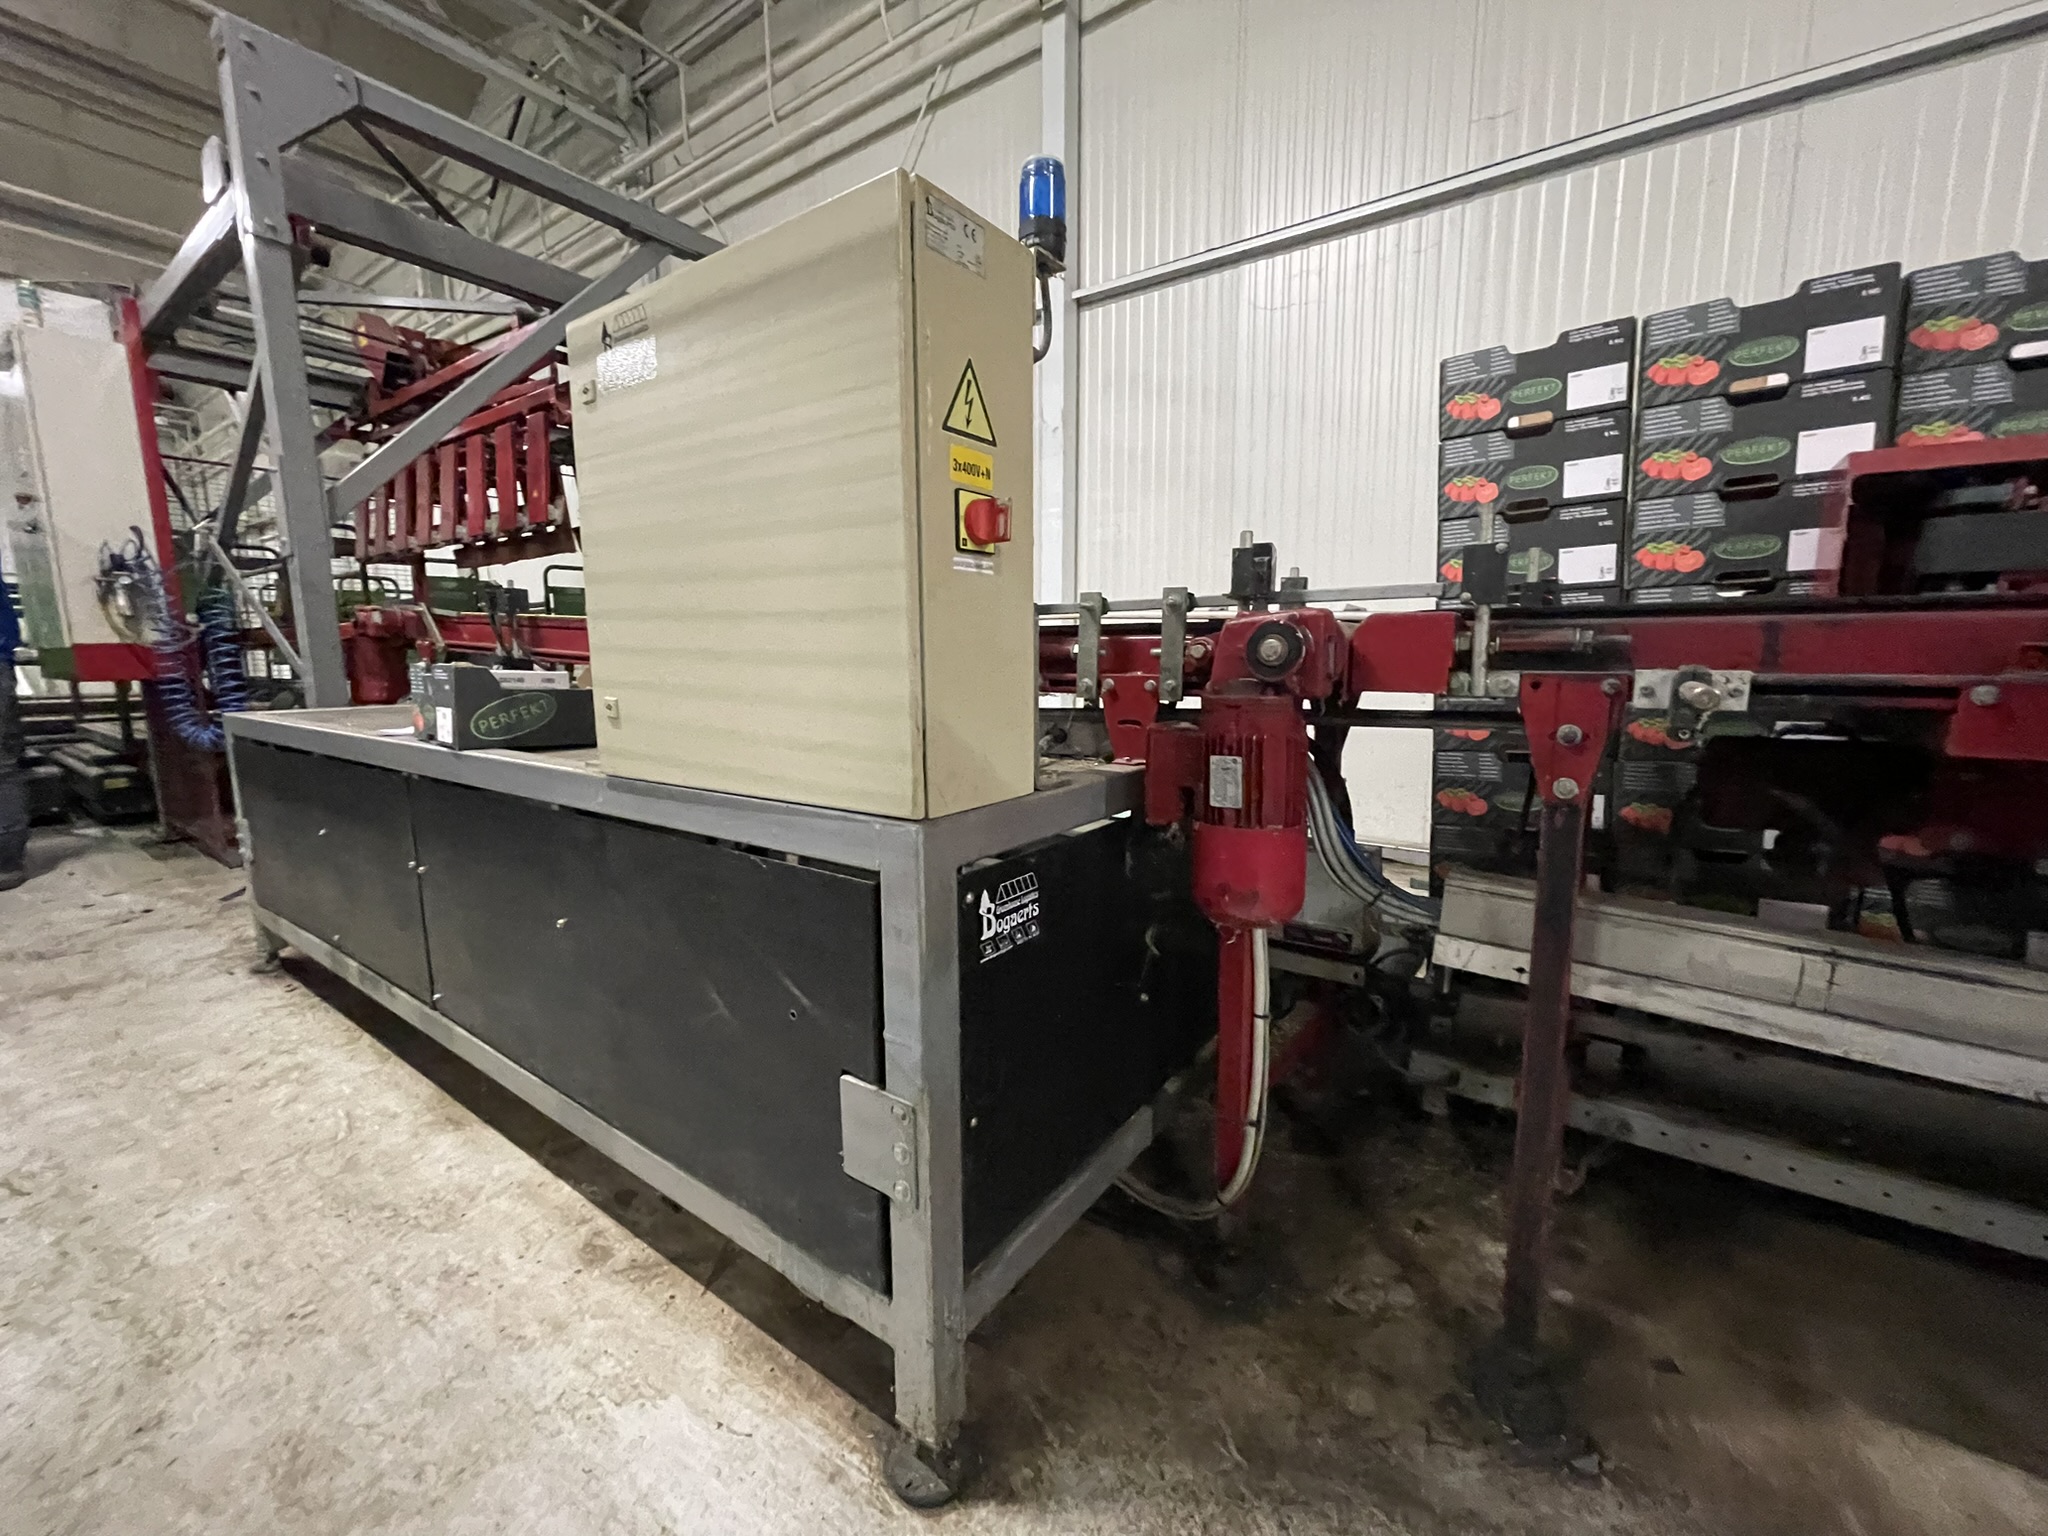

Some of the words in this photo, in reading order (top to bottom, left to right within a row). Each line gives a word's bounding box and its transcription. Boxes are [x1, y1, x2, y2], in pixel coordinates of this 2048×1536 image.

[1512, 382, 1557, 398] PERFEKT
[952, 458, 991, 480] 3x400V+N
[478, 699, 550, 734] PERFEKT
[979, 889, 1040, 941] Bogaerts
